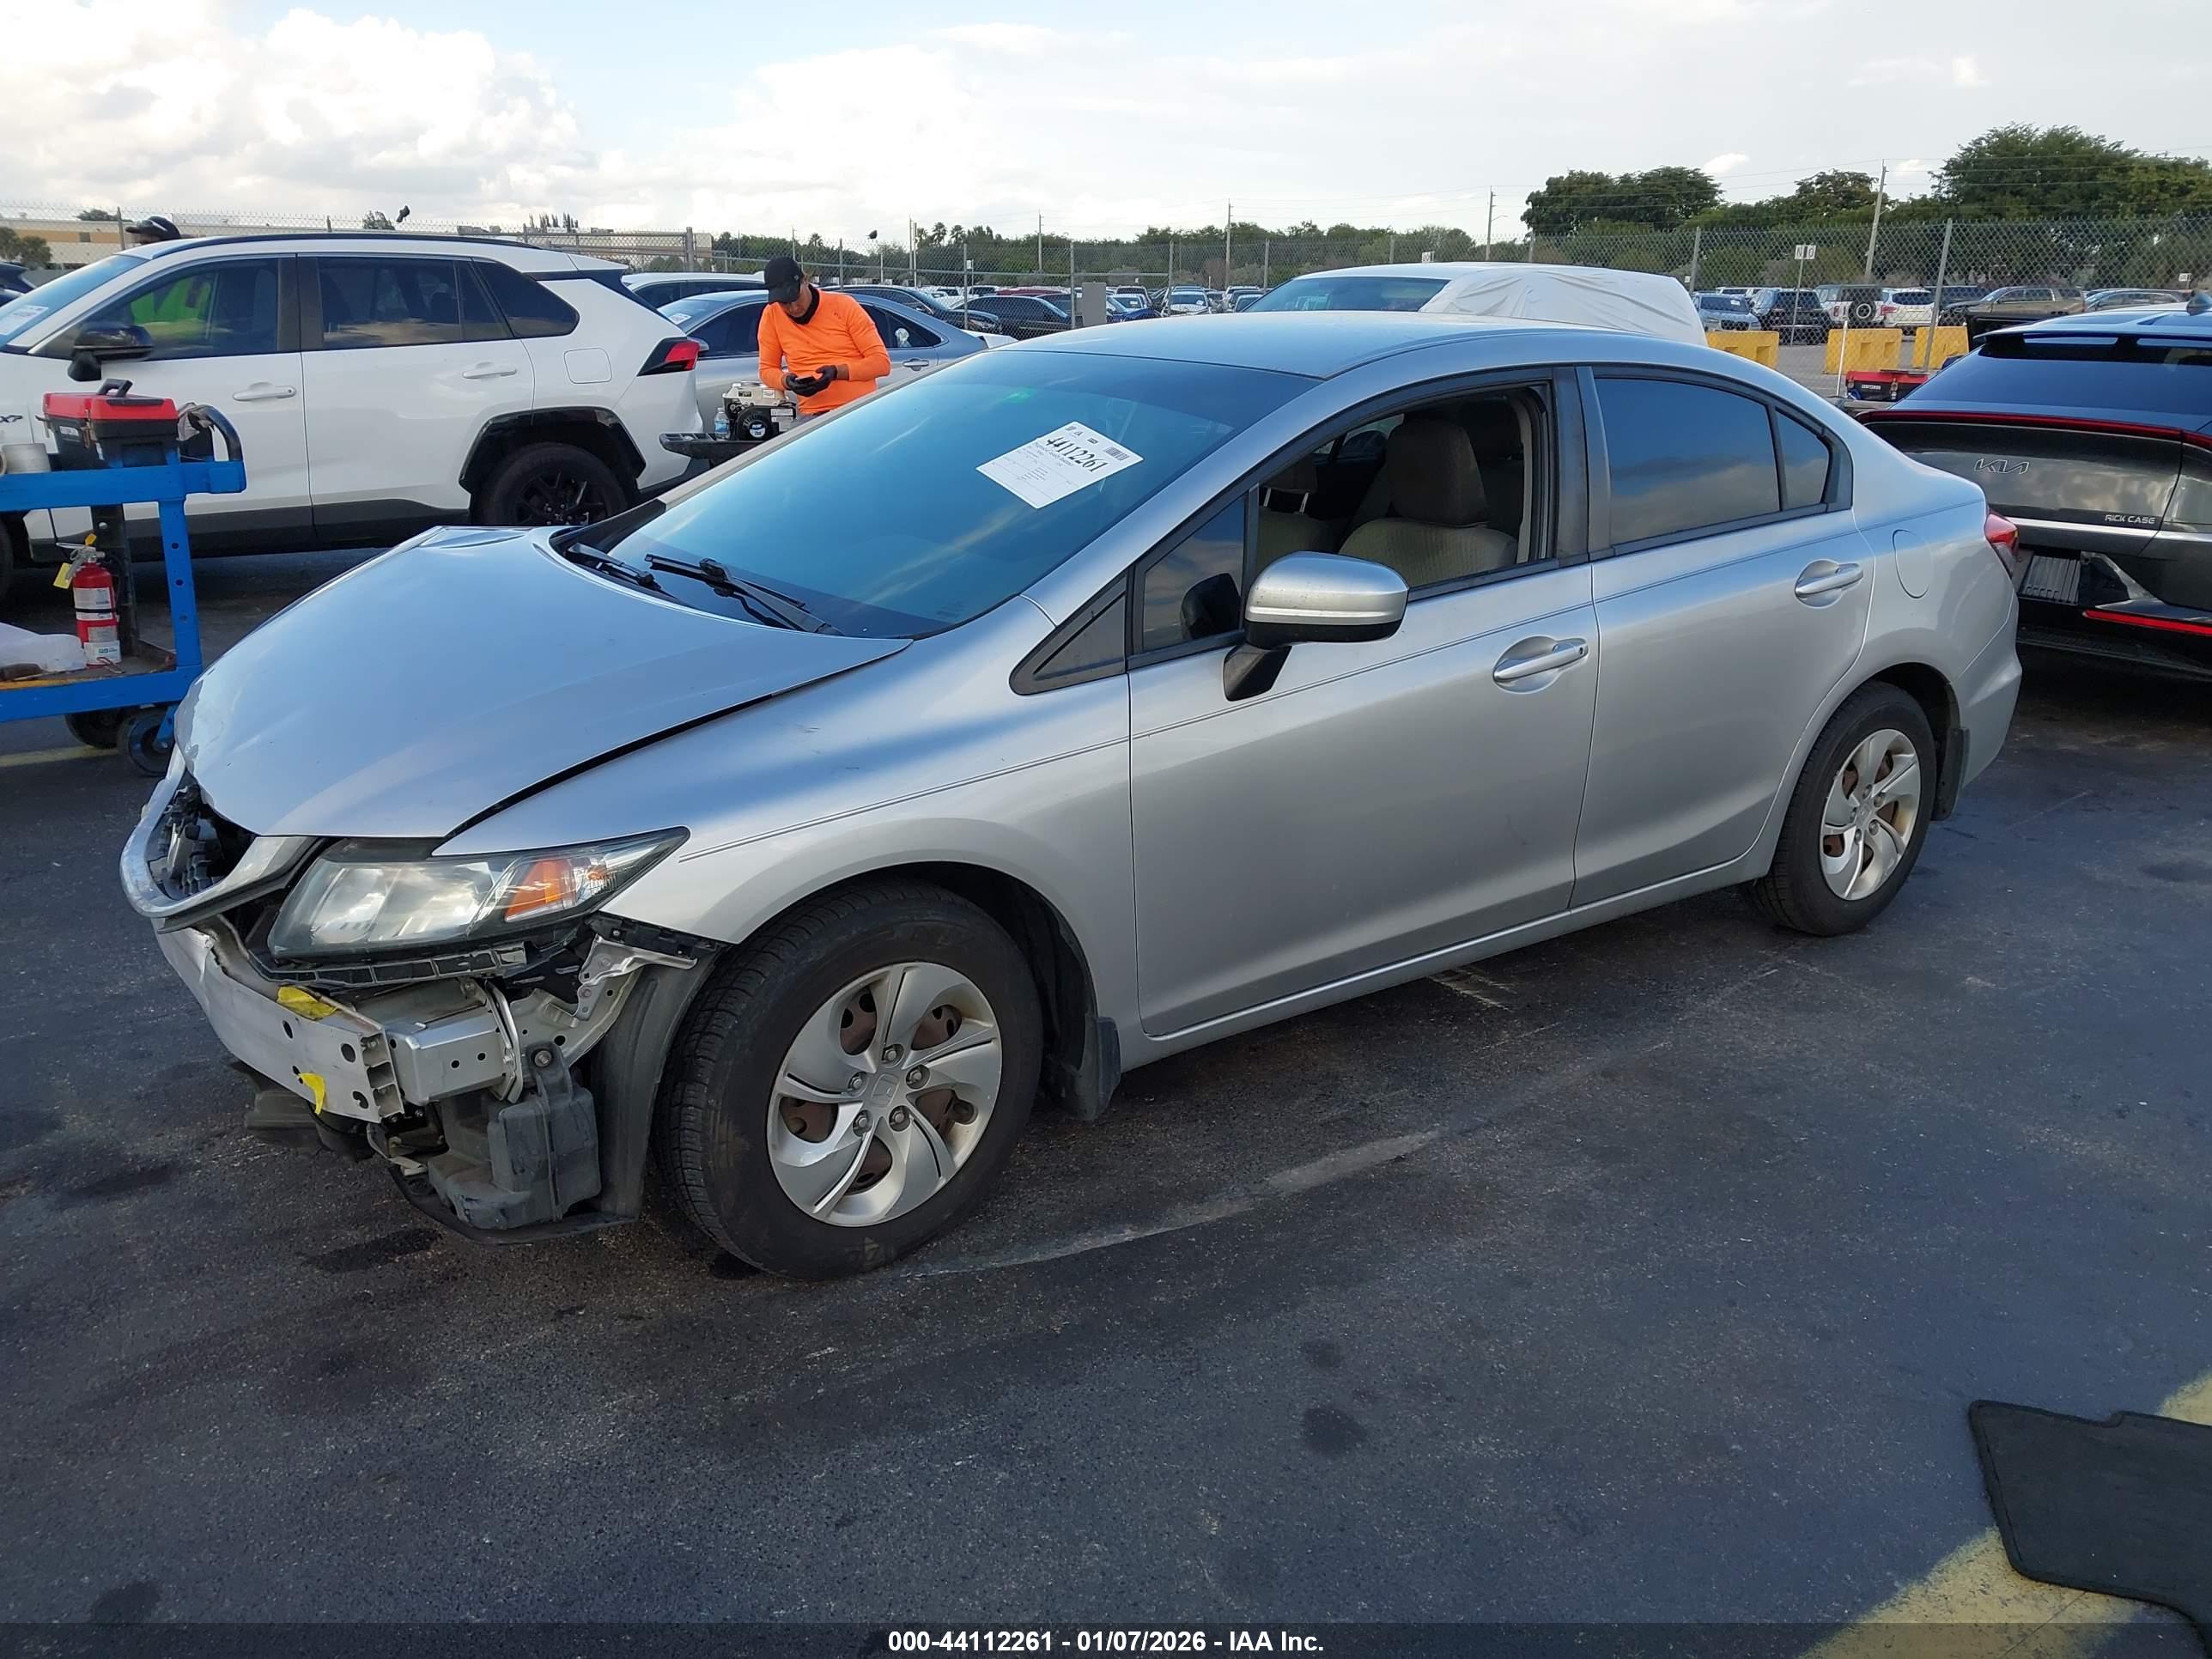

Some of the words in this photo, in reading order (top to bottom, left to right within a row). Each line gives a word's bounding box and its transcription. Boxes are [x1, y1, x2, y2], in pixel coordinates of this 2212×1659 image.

[1046, 436, 1109, 473] 44112261
[1973, 458, 2030, 475] KIA
[2105, 514, 2126, 523] RICK
[2127, 515, 2156, 525] CASE
